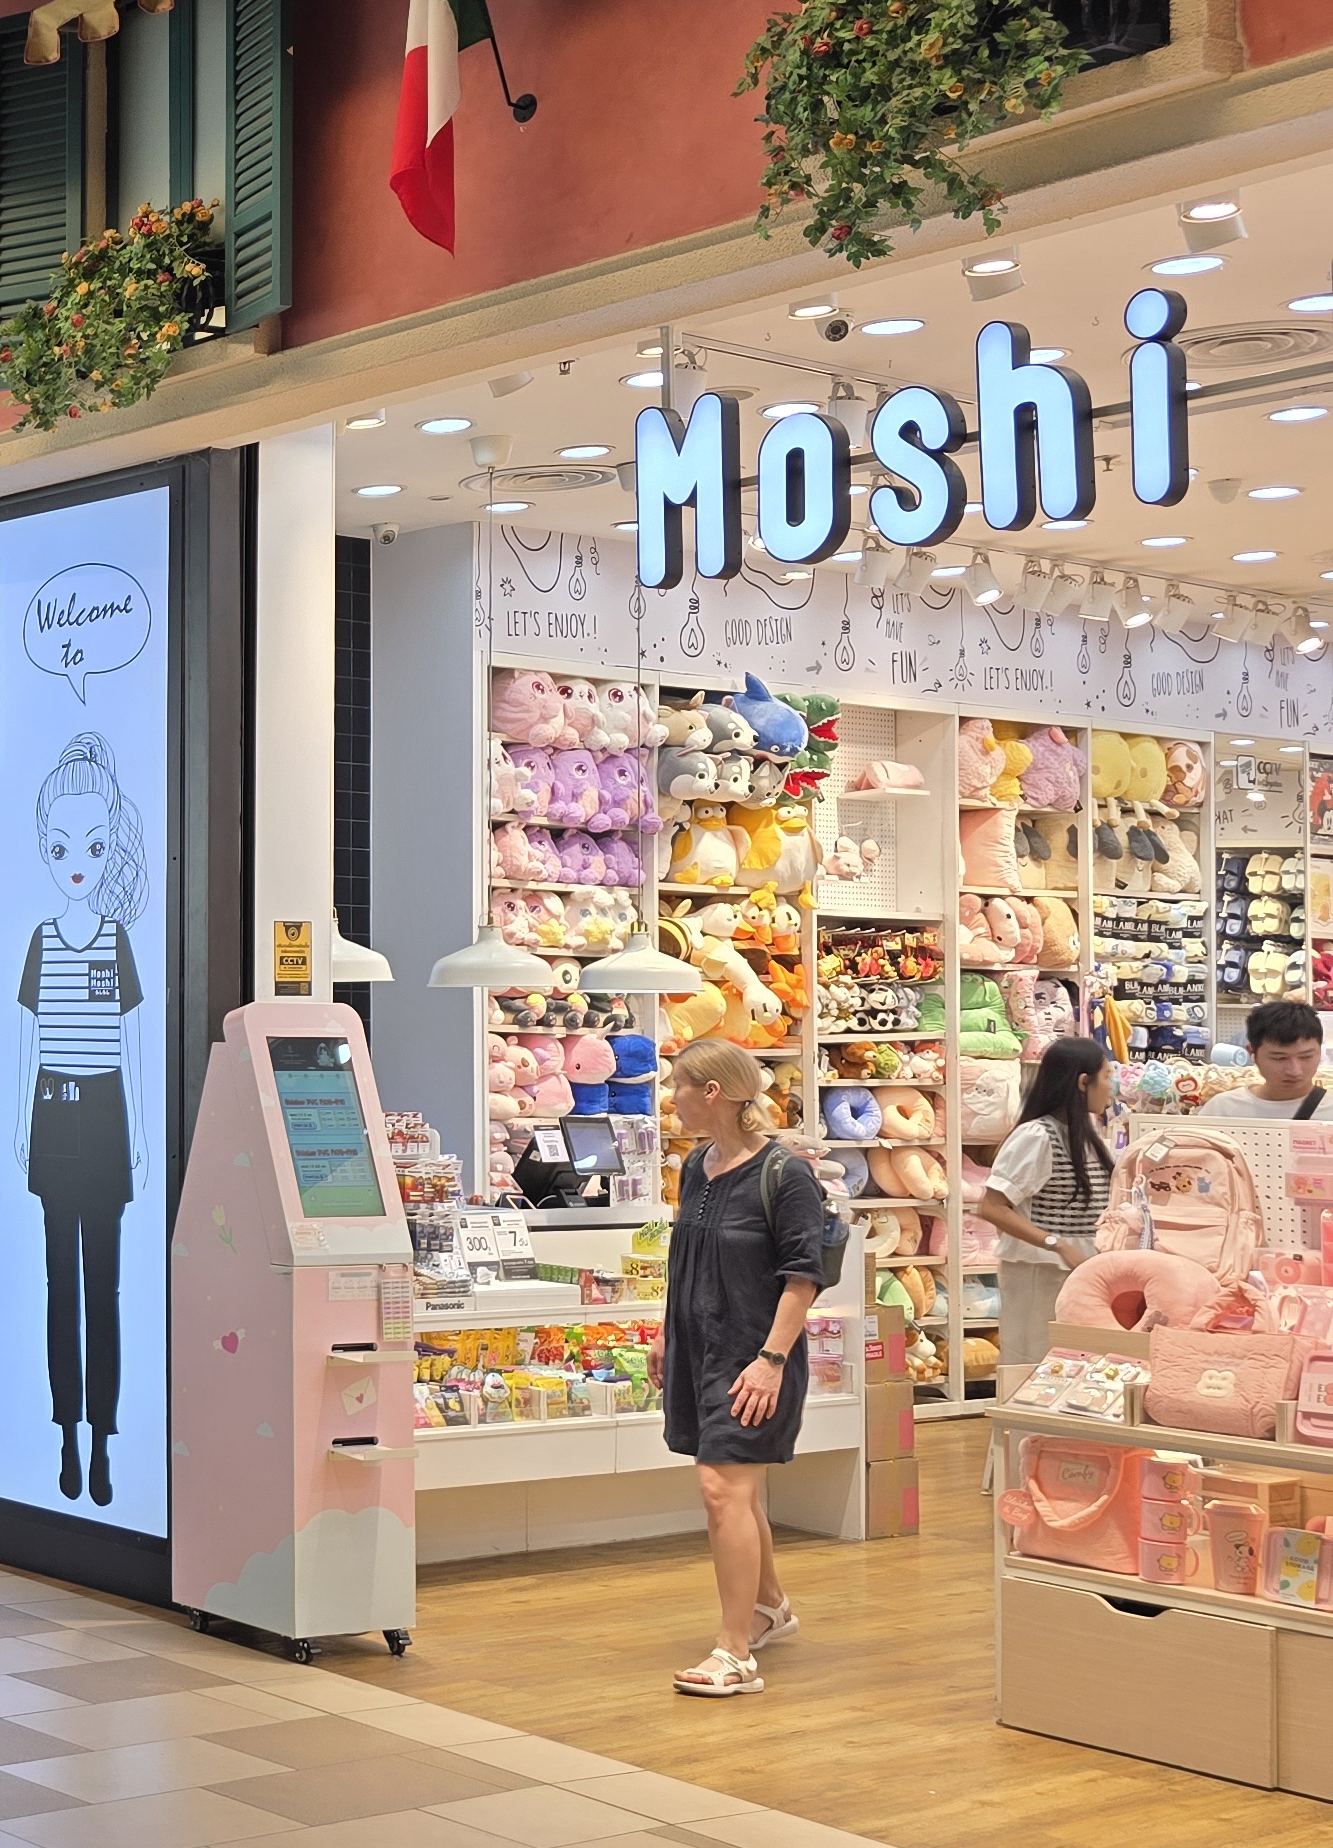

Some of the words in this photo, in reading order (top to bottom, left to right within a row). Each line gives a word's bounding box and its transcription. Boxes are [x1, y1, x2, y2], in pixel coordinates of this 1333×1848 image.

[635, 286, 1187, 589] Moshi
[37, 593, 132, 633] Welcome
[506, 610, 540, 638] LET'S
[724, 619, 752, 648] GOOD
[756, 615, 793, 646] DESIGN
[885, 617, 904, 643] HAVE
[60, 638, 85, 668] to
[891, 650, 917, 685] FUN
[984, 666, 1011, 690] LET'S
[1151, 671, 1173, 698] GOOD
[1176, 668, 1205, 696] DESIGN
[1279, 698, 1299, 729] FUN
[282, 957, 303, 965] CCTV
[466, 1236, 488, 1251] 300
[426, 1299, 465, 1311] Panasonic
